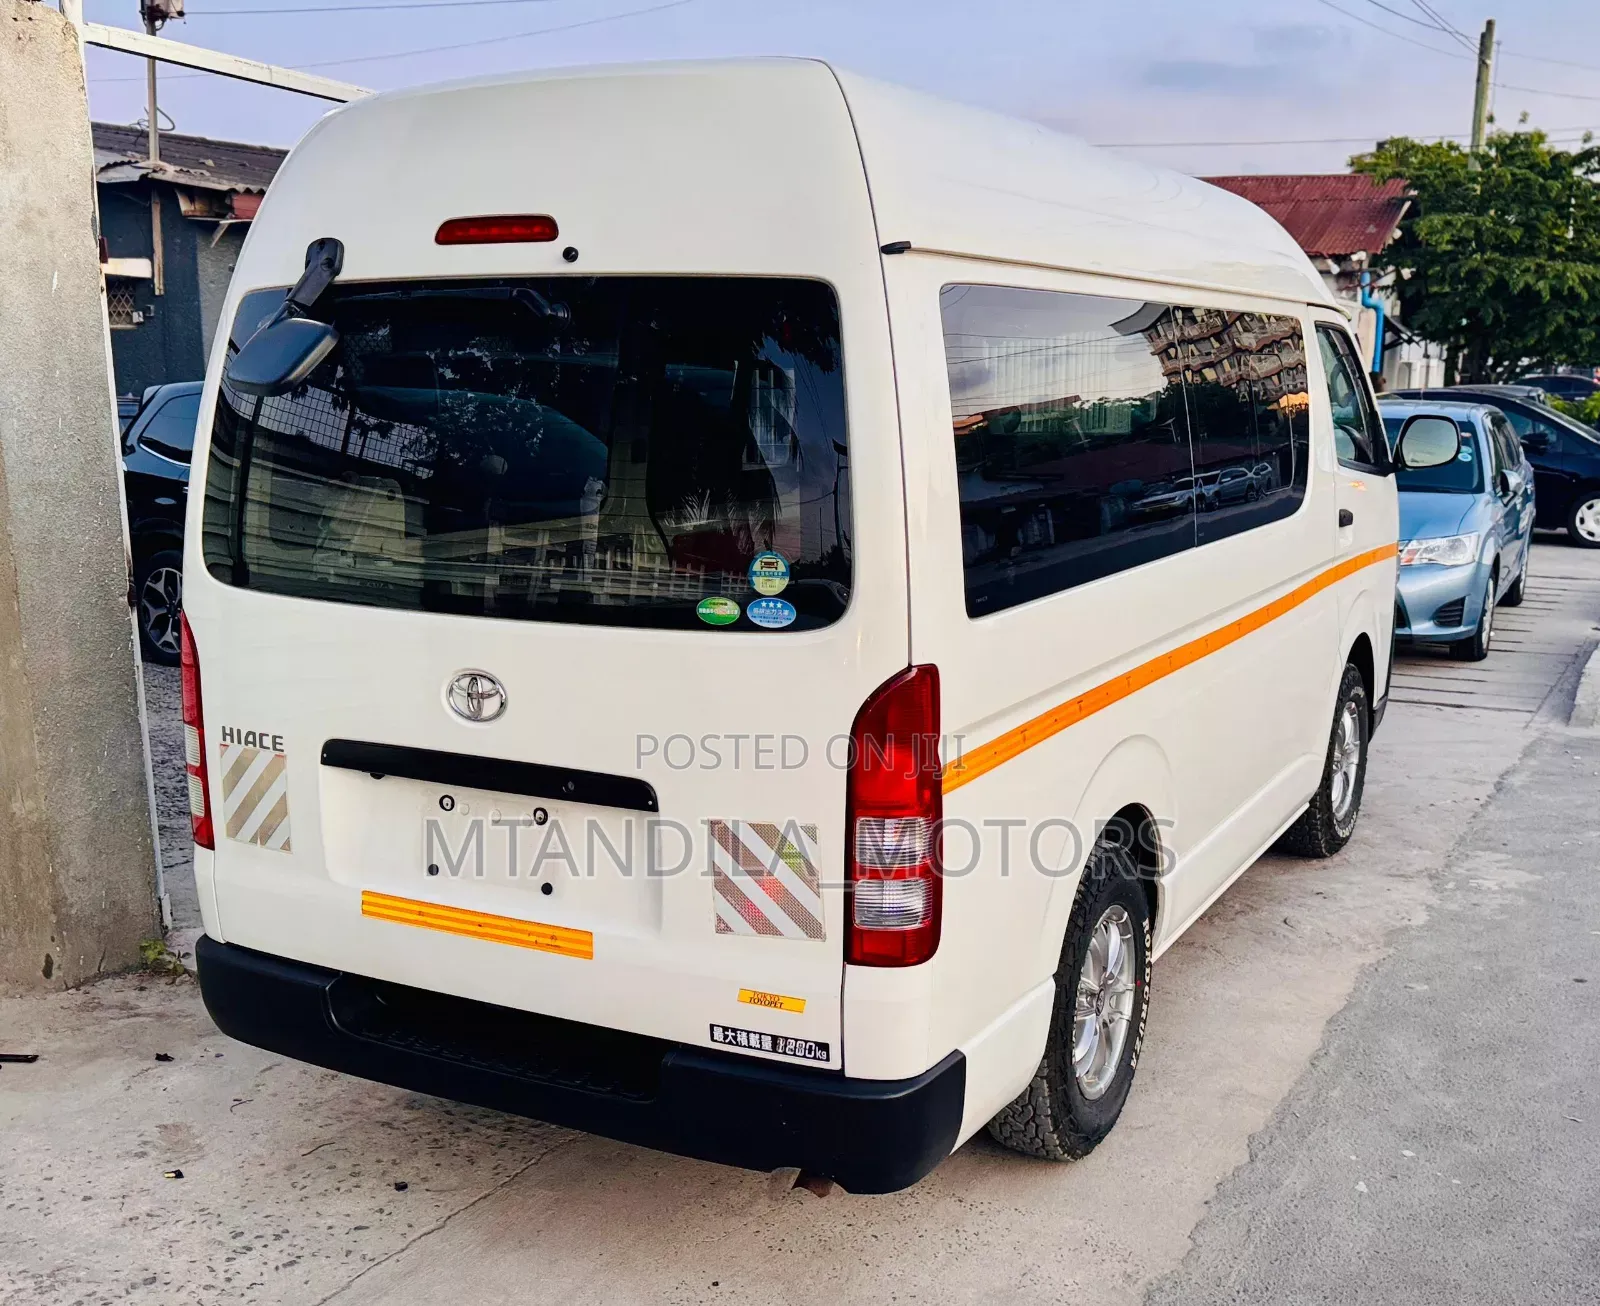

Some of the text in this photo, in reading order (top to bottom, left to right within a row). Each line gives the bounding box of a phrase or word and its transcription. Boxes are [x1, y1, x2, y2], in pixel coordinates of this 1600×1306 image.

[222, 725, 284, 752] HIACE
[749, 997, 784, 1009] TOYOPET
[753, 991, 780, 1001] TOKYO
[712, 1026, 773, 1051] 最大積載量
